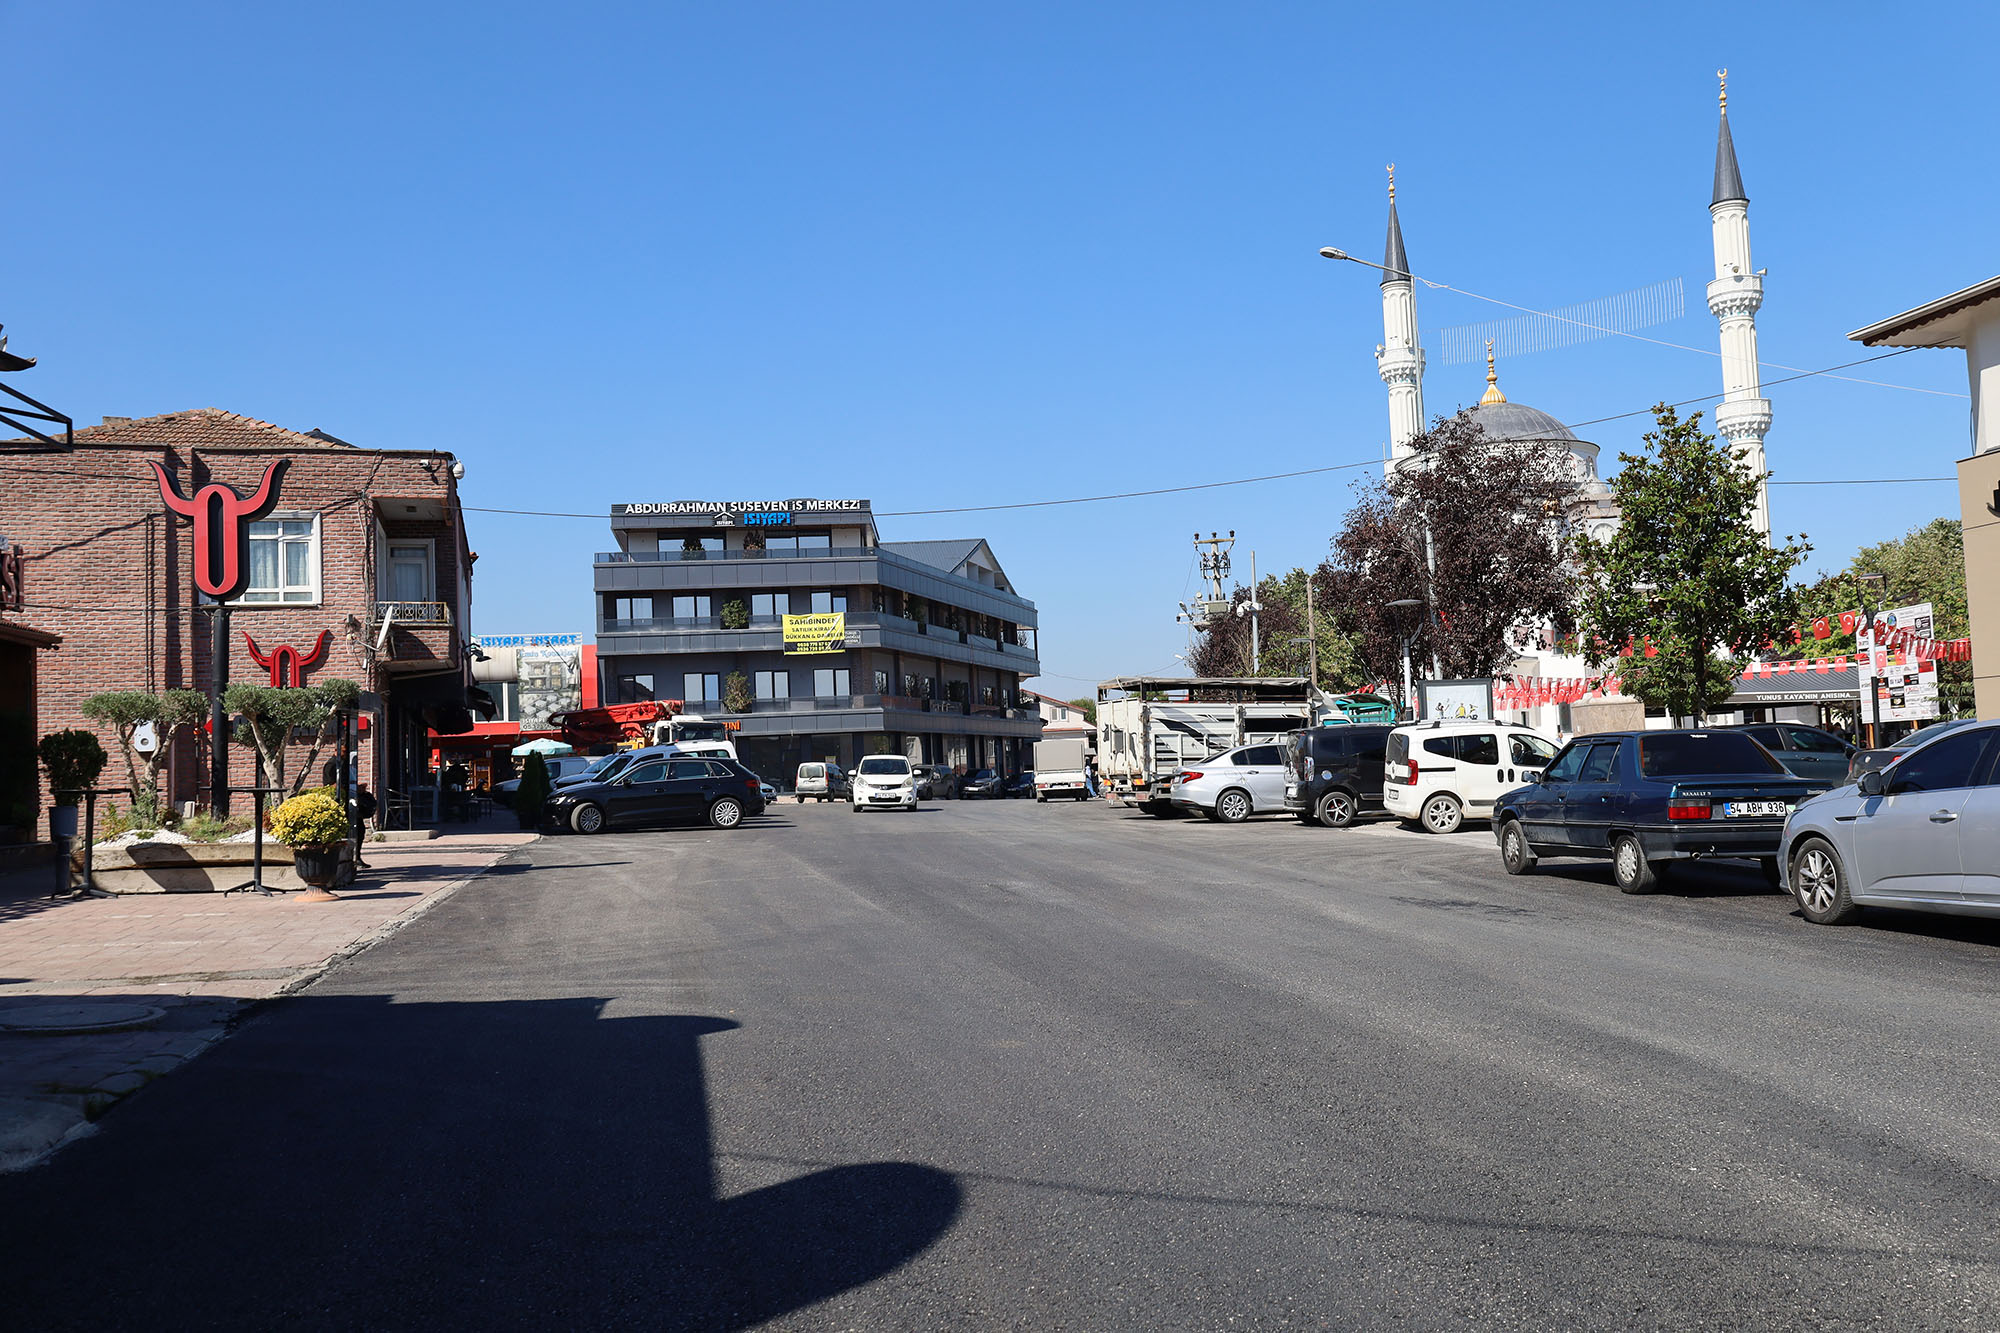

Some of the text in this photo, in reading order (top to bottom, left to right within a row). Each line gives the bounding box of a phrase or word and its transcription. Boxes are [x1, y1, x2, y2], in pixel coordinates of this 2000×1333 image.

[625, 502, 727, 514] ABDURRAHMAN
[730, 501, 789, 512] SUSEVEN
[743, 512, 791, 525] ISIYAPI
[1730, 801, 1785, 814] 54 ABH 936
